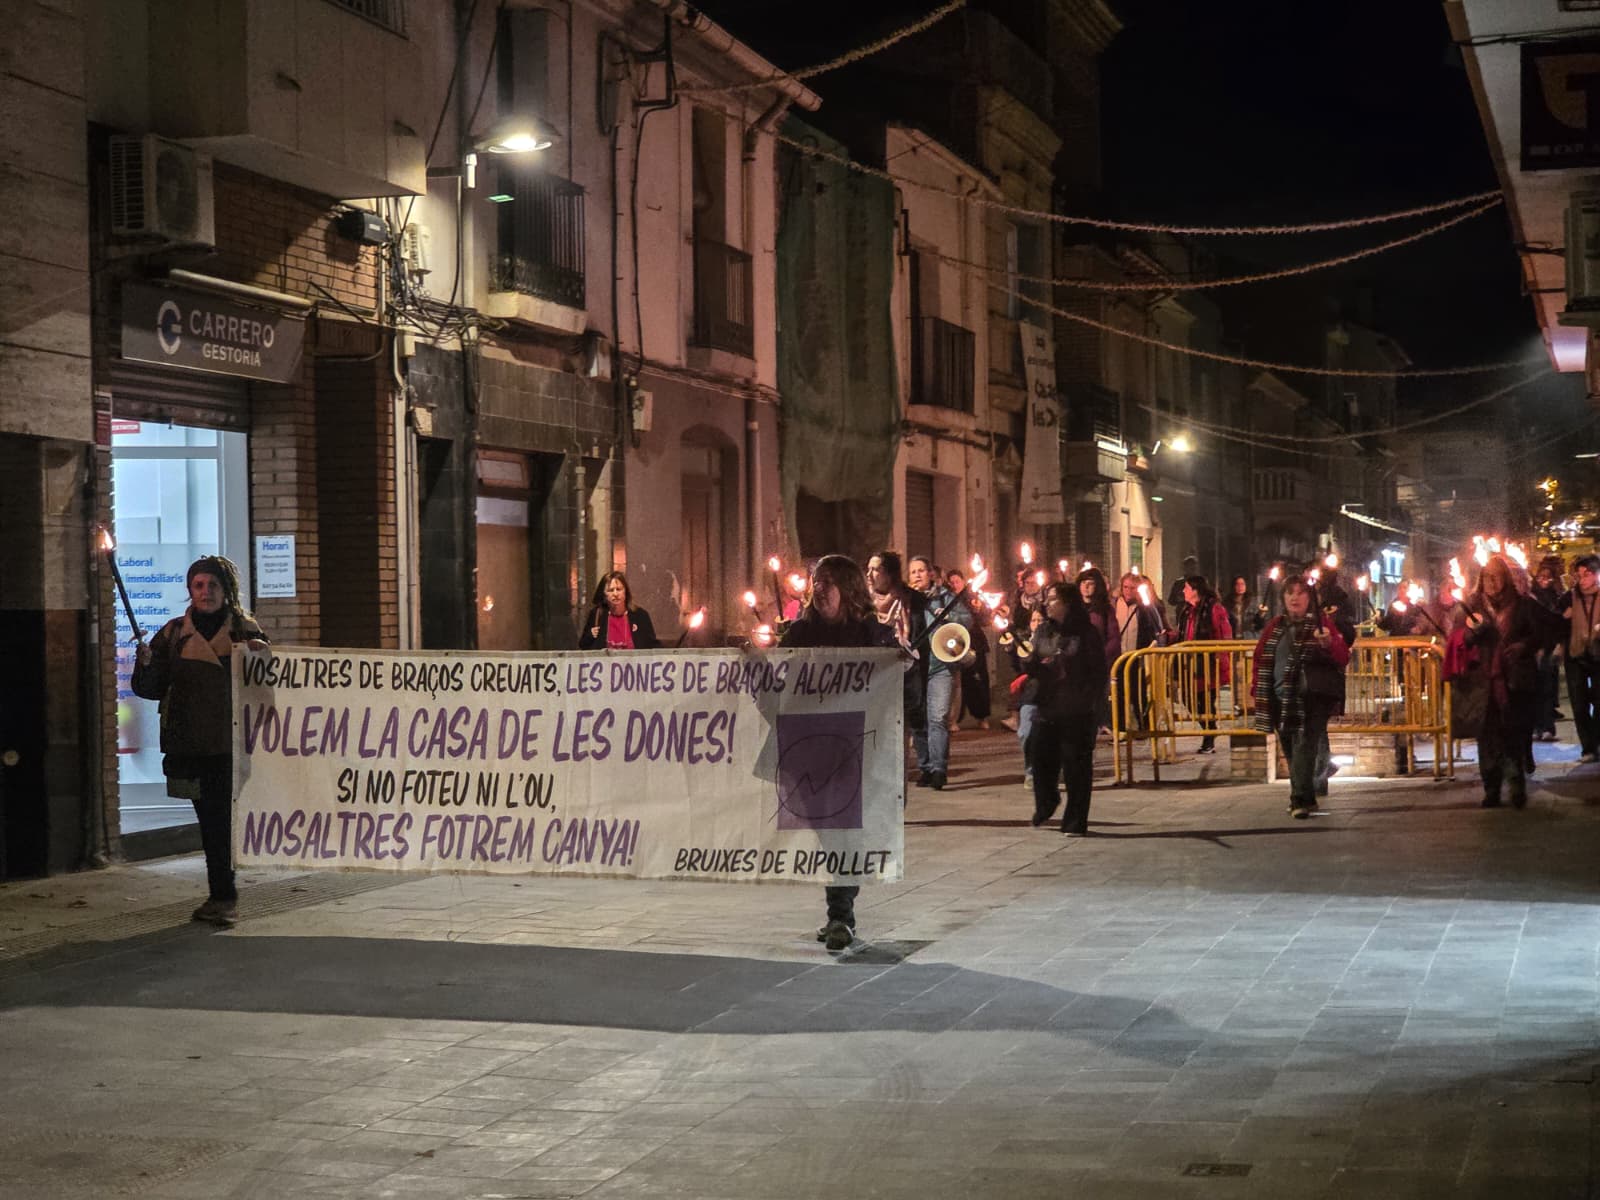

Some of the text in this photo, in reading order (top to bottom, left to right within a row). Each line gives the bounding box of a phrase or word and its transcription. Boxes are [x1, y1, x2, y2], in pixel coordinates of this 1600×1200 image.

[190, 310, 274, 348] CARRERO
[202, 342, 261, 367] GESTORIA
[262, 541, 289, 550] Horari
[243, 658, 876, 703] VOSALTRES DE BRAÇOS CREUATS, LES DONES DE BRAÇOS ALÇATS!
[243, 703, 737, 765] VOLEM LA CASA DE LES DONES!
[337, 767, 359, 804] SI
[366, 769, 396, 804] NO
[401, 769, 471, 806] FOTEU
[476, 770, 500, 808] NI
[243, 809, 641, 866] NOSALTRES FOTREM CANYA!
[674, 847, 892, 875] BRUIXES DE RIPOLLET
